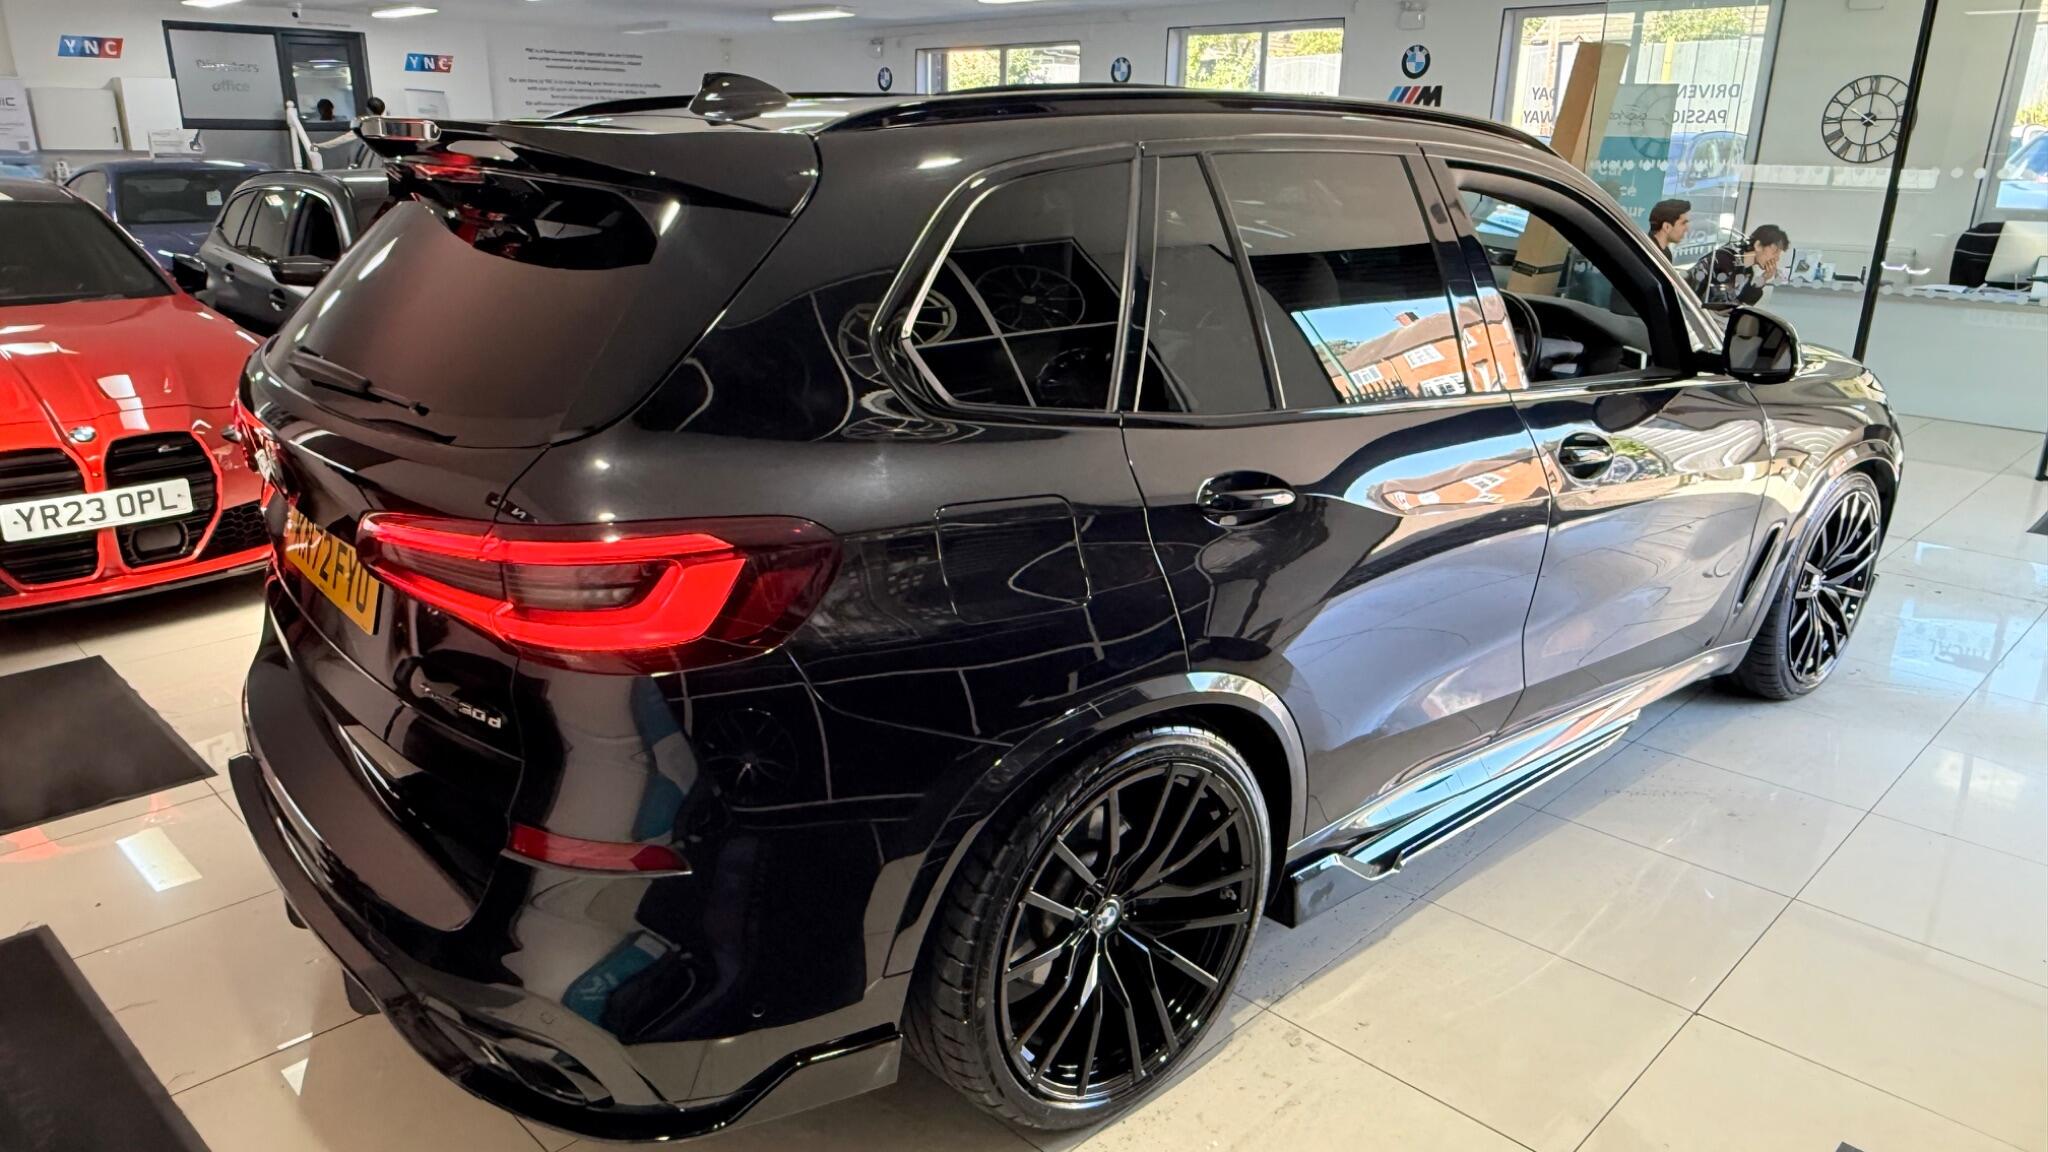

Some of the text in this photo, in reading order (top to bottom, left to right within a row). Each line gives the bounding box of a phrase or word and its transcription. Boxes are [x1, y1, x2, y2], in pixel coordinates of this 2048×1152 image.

[63, 39, 118, 56] YNC
[409, 56, 449, 70] YNC
[16, 487, 178, 533] YR23 OPL
[333, 541, 370, 614] FYU
